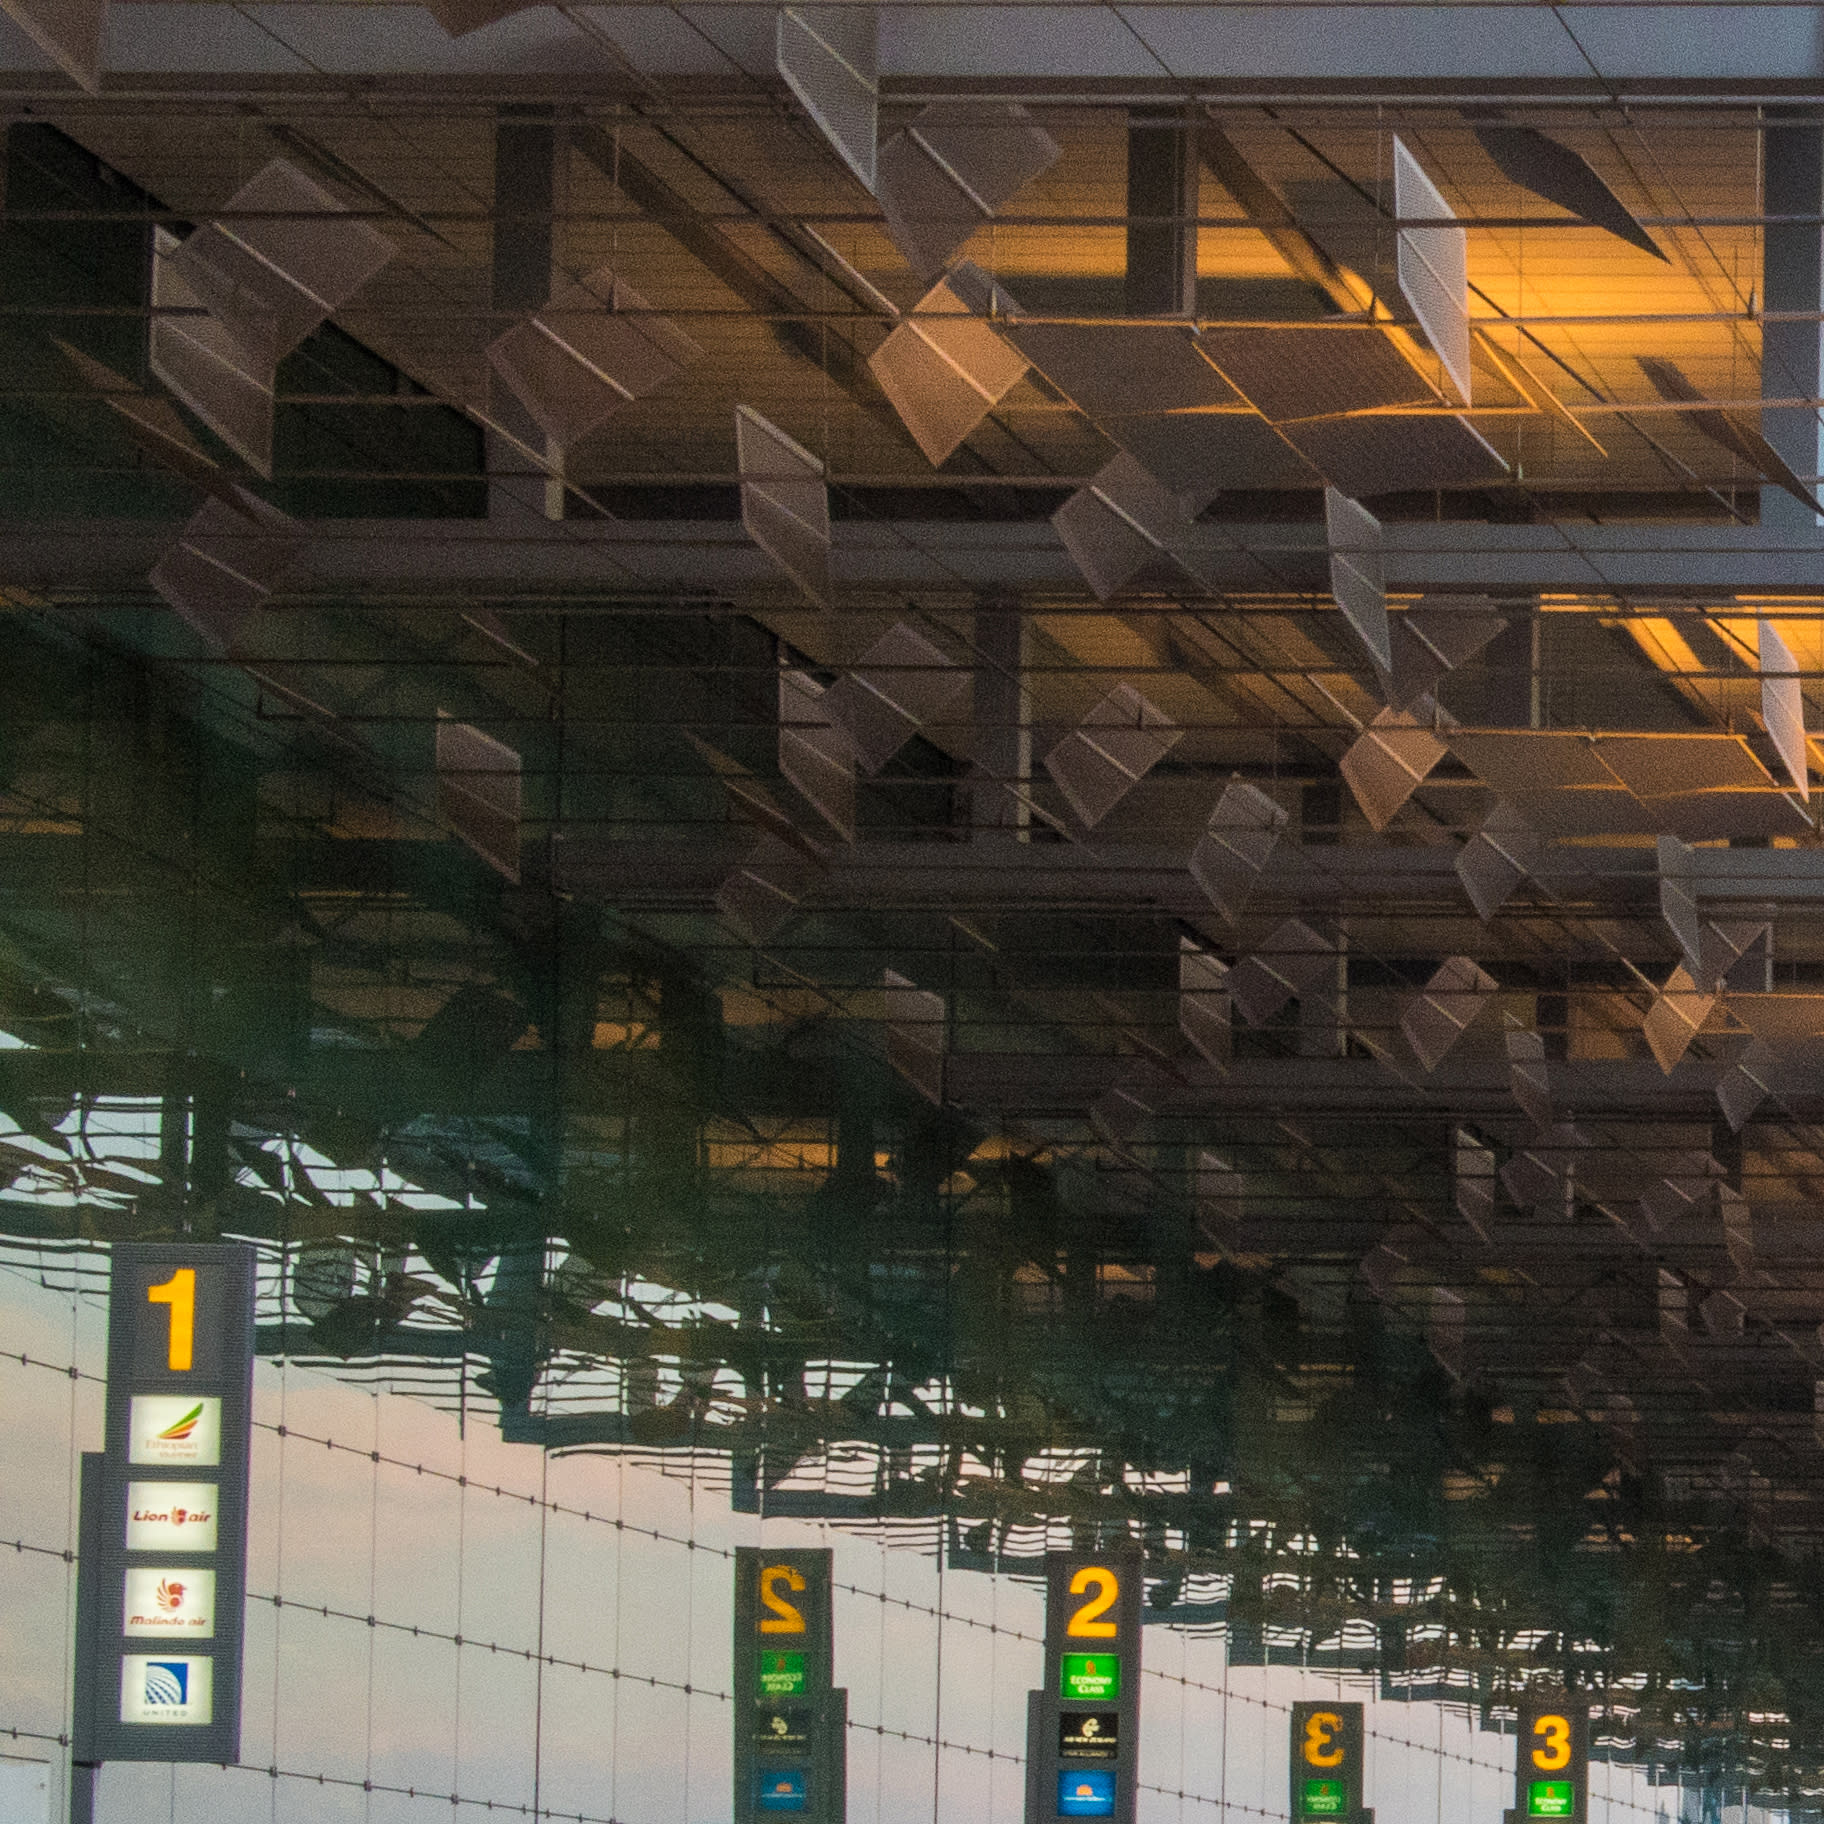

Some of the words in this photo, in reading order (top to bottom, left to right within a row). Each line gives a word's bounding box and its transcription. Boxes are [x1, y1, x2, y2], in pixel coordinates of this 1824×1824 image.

[147, 1268, 196, 1371] 1
[133, 1510, 168, 1521] Lion
[188, 1510, 211, 1522] air
[1067, 1566, 1119, 1637] 2
[188, 1616, 206, 1626] air
[1070, 1675, 1112, 1685] ECONOMY
[1078, 1685, 1105, 1694] CLASS
[1532, 1715, 1571, 1770] 3
